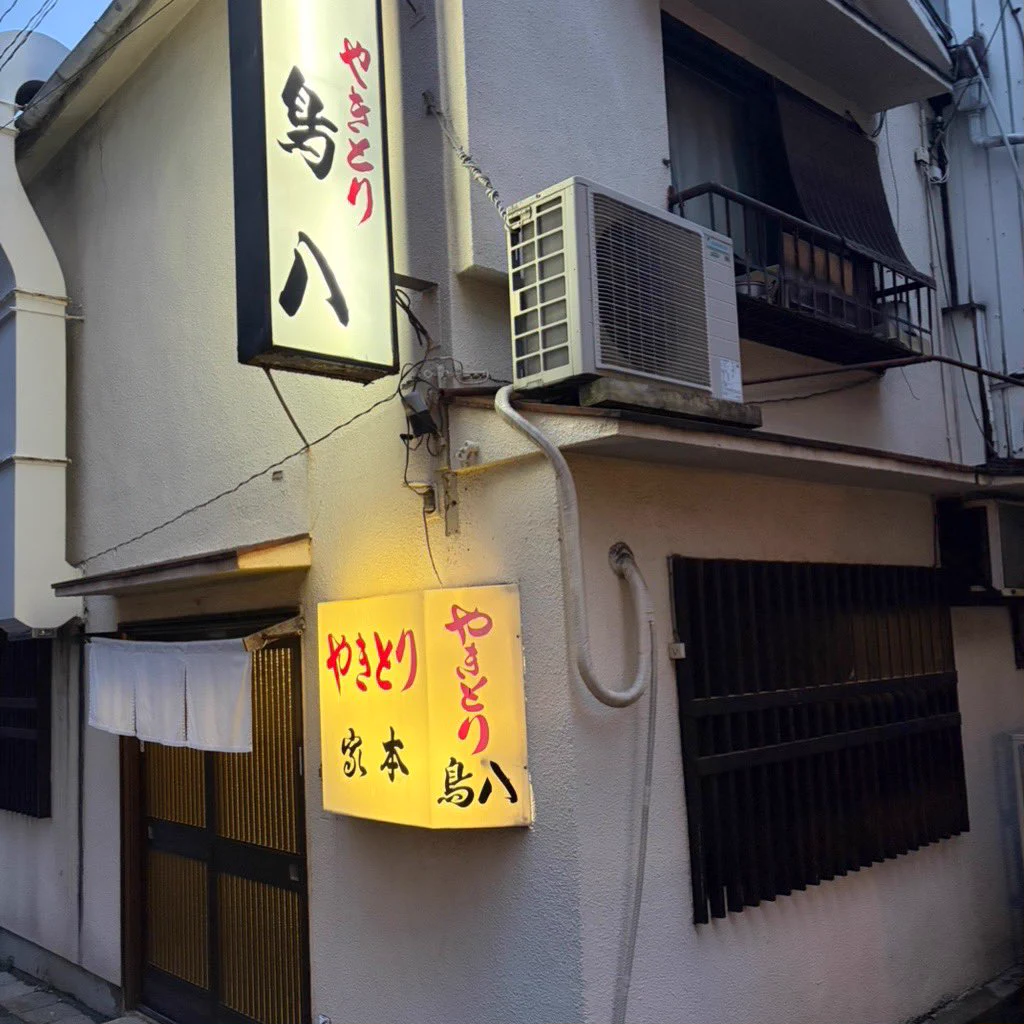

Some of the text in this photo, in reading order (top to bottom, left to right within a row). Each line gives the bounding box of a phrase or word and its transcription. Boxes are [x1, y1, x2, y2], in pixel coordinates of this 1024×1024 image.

[277, 65, 349, 327] 鳥八
[339, 37, 374, 226] やきとり
[326, 628, 418, 696] やきとり
[445, 604, 493, 755] やきとり
[437, 757, 519, 807] 鳥八
